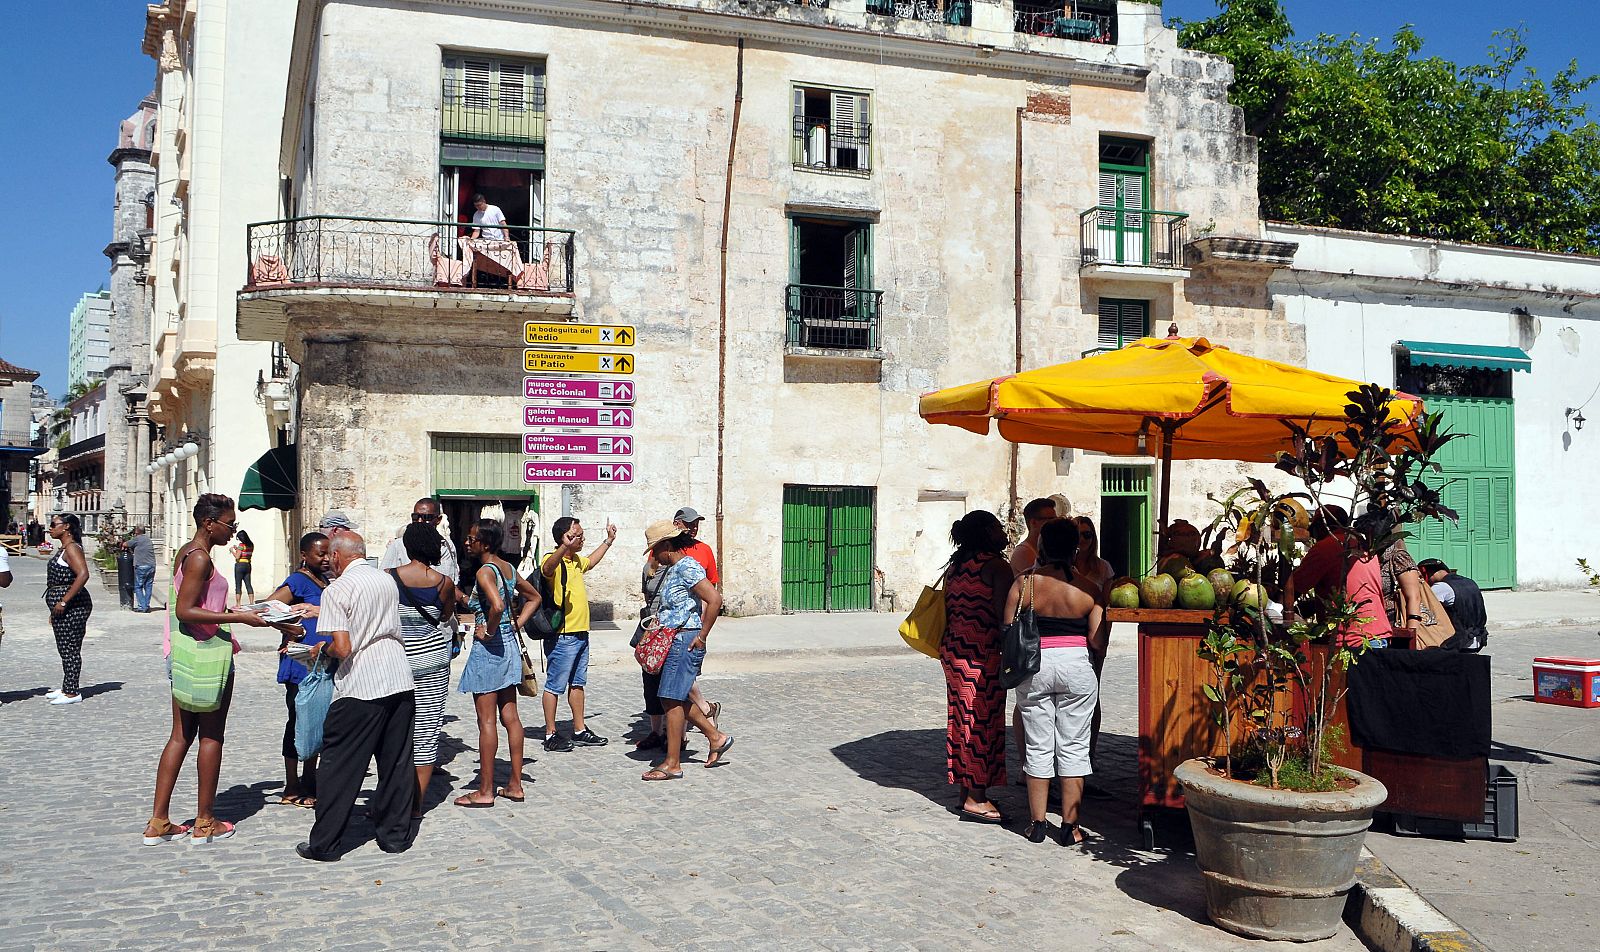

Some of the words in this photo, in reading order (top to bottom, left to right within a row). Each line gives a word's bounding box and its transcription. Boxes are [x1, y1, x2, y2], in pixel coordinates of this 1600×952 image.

[538, 326, 578, 334] bodeguita
[529, 333, 559, 341] Medio
[540, 360, 566, 368] Patio
[550, 388, 586, 397] Colonial
[557, 416, 590, 424] Manuel
[527, 443, 566, 451] Wilfredo
[527, 468, 577, 477] Catedral
